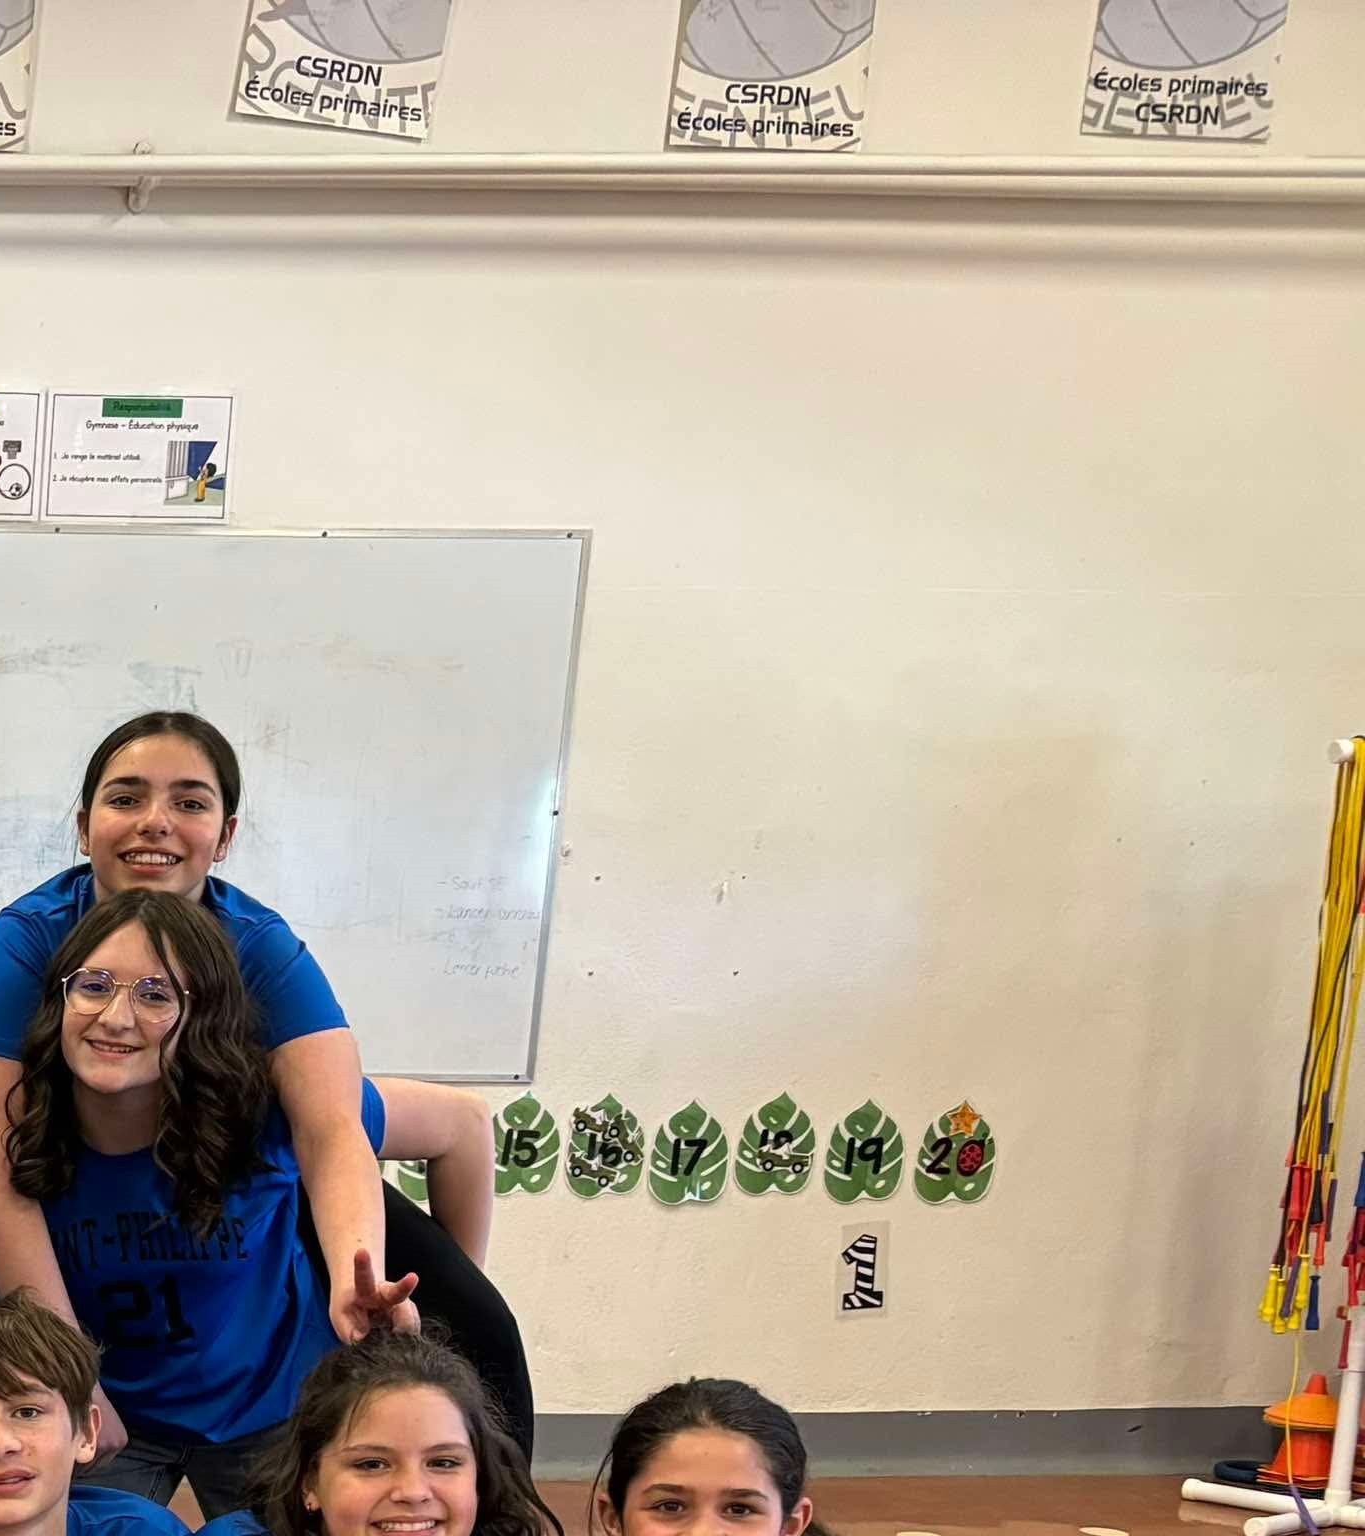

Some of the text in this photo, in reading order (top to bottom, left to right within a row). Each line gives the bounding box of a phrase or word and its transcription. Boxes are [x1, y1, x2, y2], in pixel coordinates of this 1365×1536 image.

[295, 55, 383, 87] CSRDN
[1093, 66, 1269, 97] Écoles primaires
[245, 76, 423, 122] Écoles primaires
[725, 84, 811, 107] CSRDN
[1135, 102, 1221, 125] CSRDN
[677, 106, 854, 137] Écoles primaires
[86, 420, 119, 431] Gymnase
[128, 419, 165, 430] Éducation
[167, 422, 199, 432] physique
[501, 1130, 541, 1169] 15
[670, 1138, 708, 1177] 17
[844, 1137, 884, 1175] 19
[925, 1137, 985, 1177] 20
[841, 1233, 883, 1311] 1
[97, 1274, 195, 1350] 21
